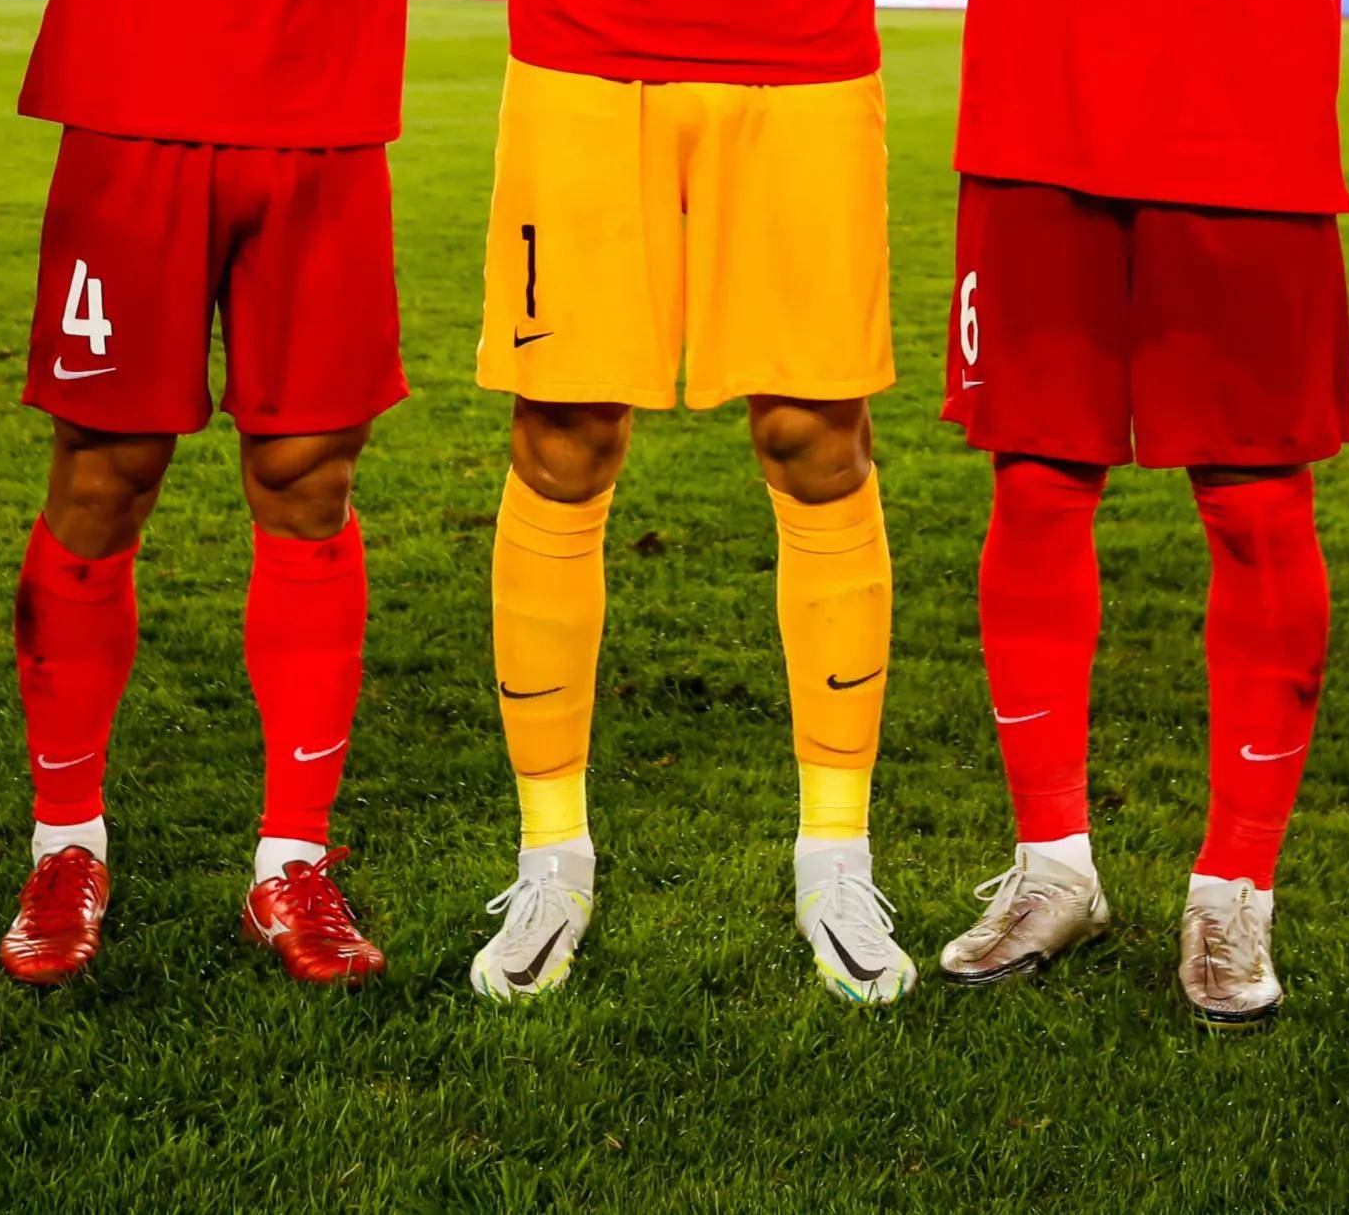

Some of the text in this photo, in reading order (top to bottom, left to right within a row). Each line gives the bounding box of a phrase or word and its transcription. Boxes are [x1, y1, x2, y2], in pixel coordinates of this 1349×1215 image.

[61, 258, 113, 355] 4
[521, 224, 536, 319] 1
[960, 270, 979, 366] 6
